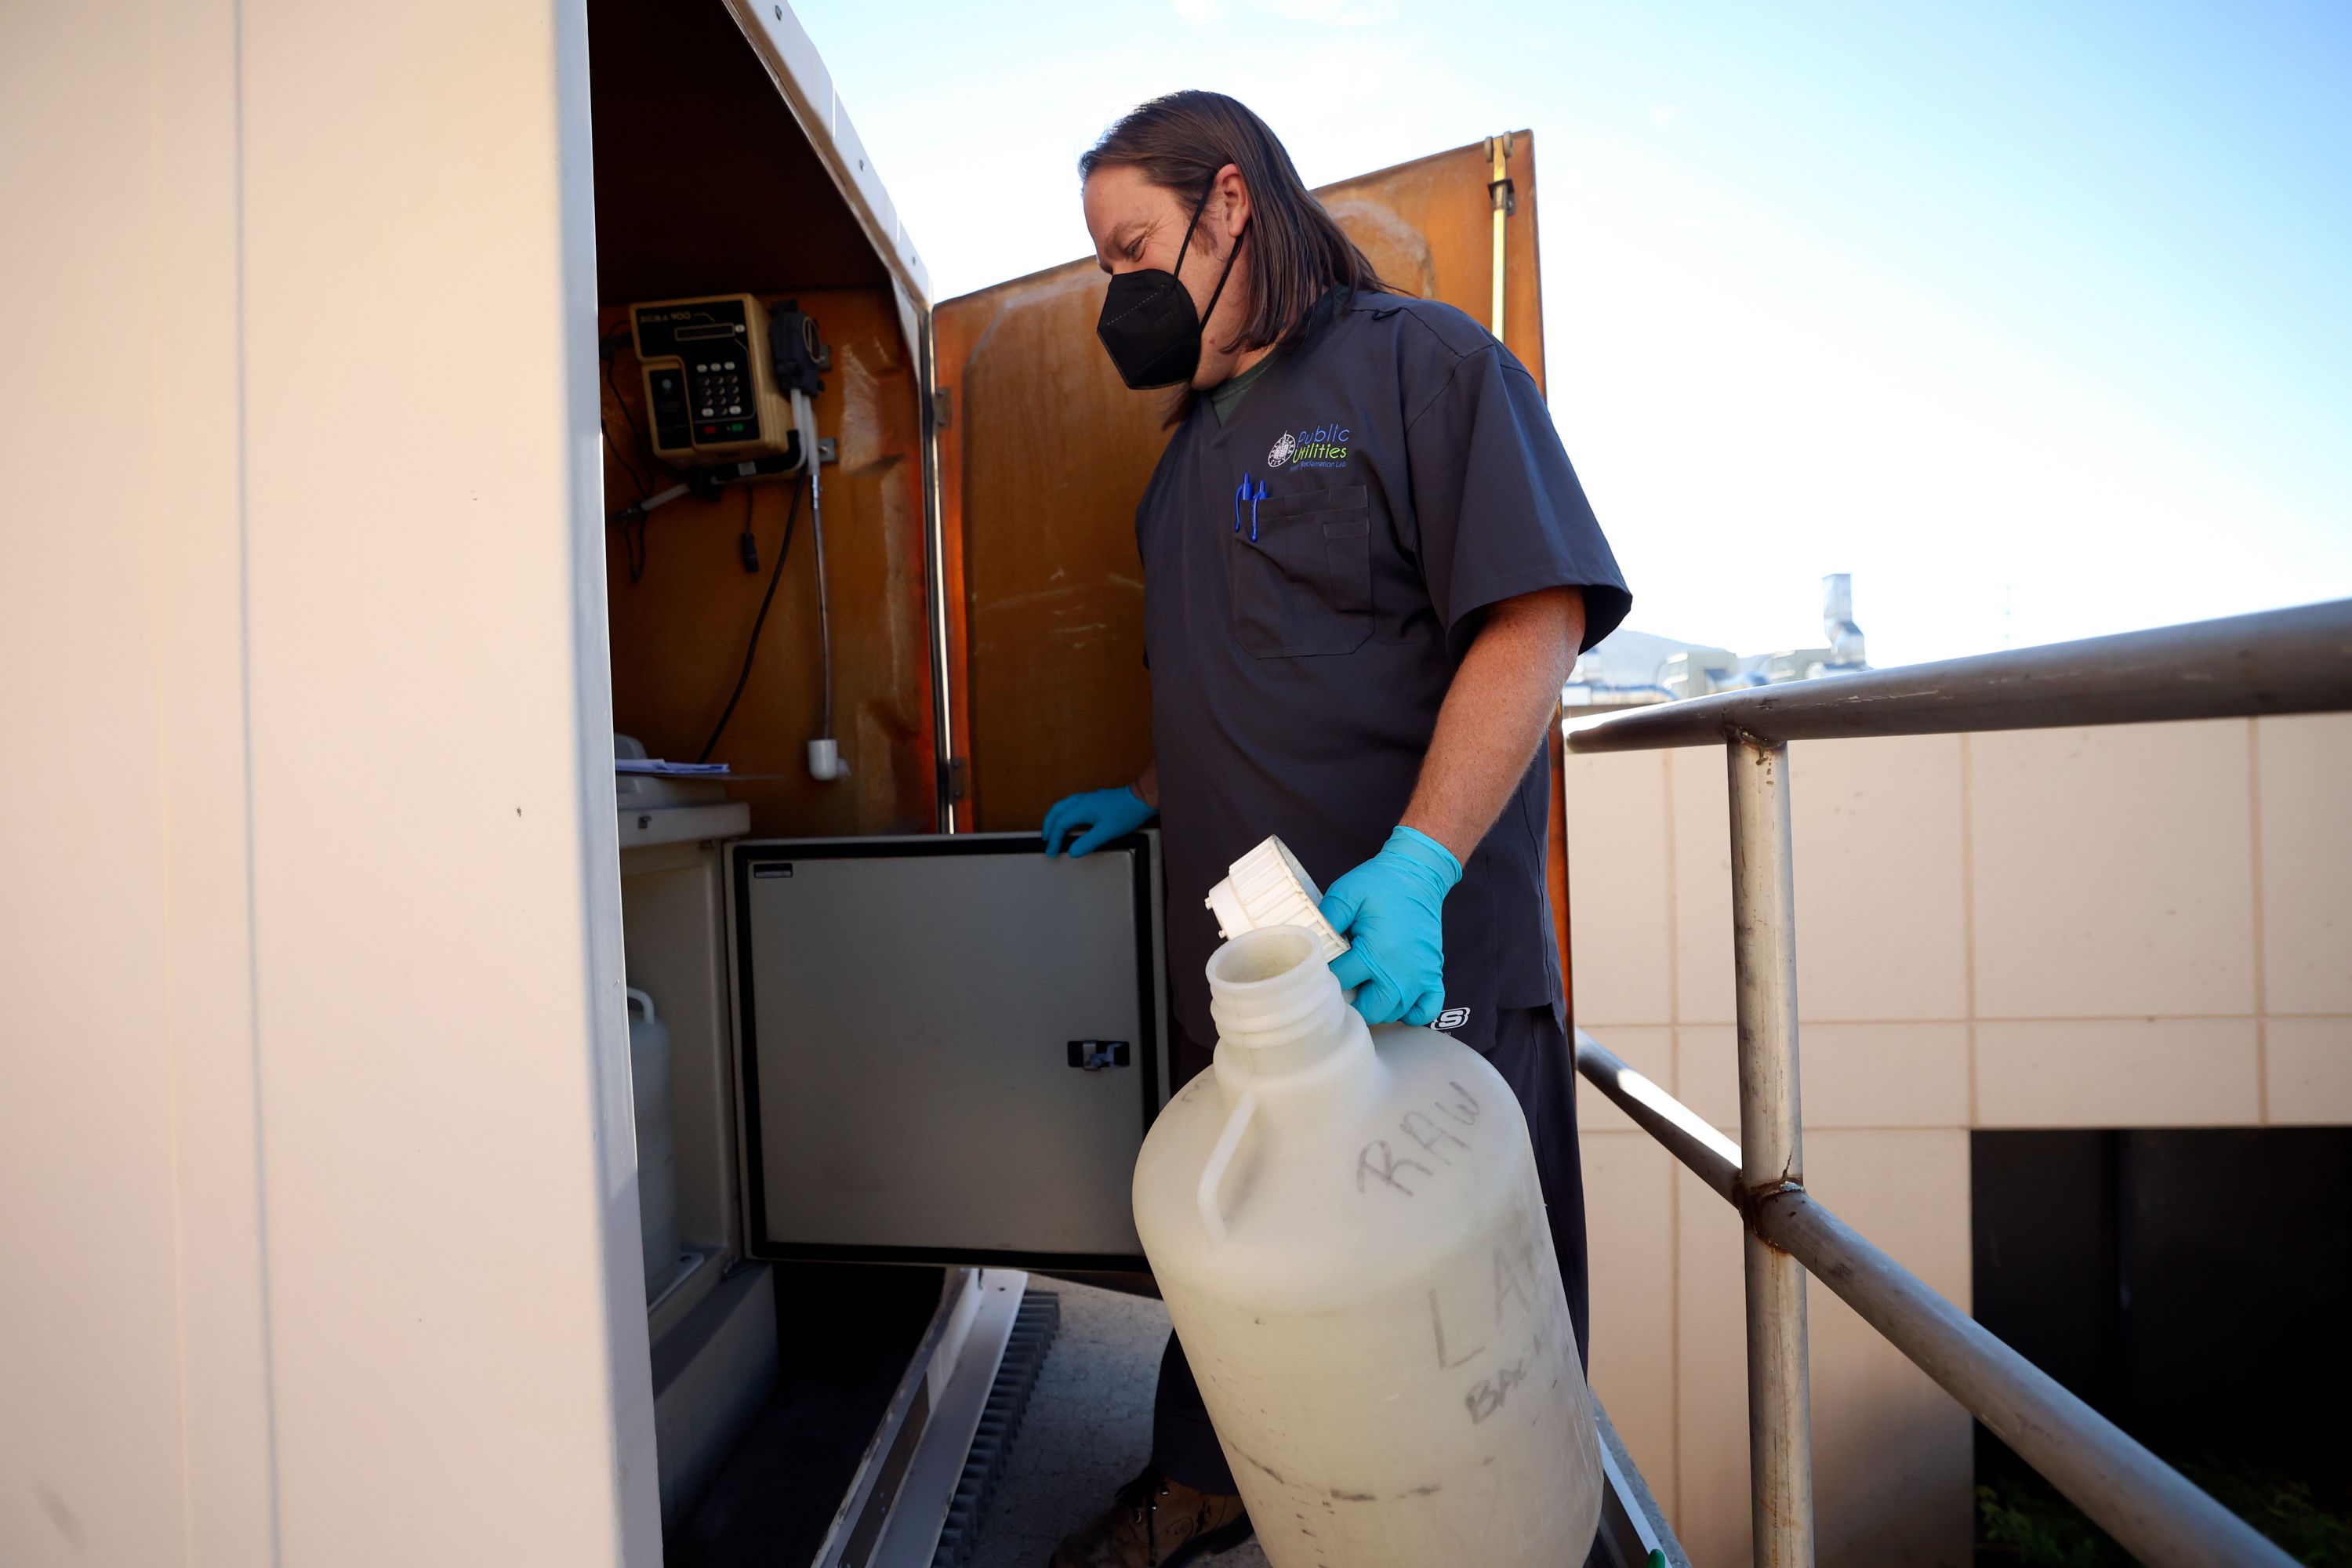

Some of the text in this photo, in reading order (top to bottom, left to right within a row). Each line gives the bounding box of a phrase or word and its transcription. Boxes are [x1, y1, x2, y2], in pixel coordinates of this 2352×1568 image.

[1292, 442, 1347, 463] Utilities
[1300, 459, 1335, 468] Reclamation
[1356, 1080, 1481, 1197] RAW
